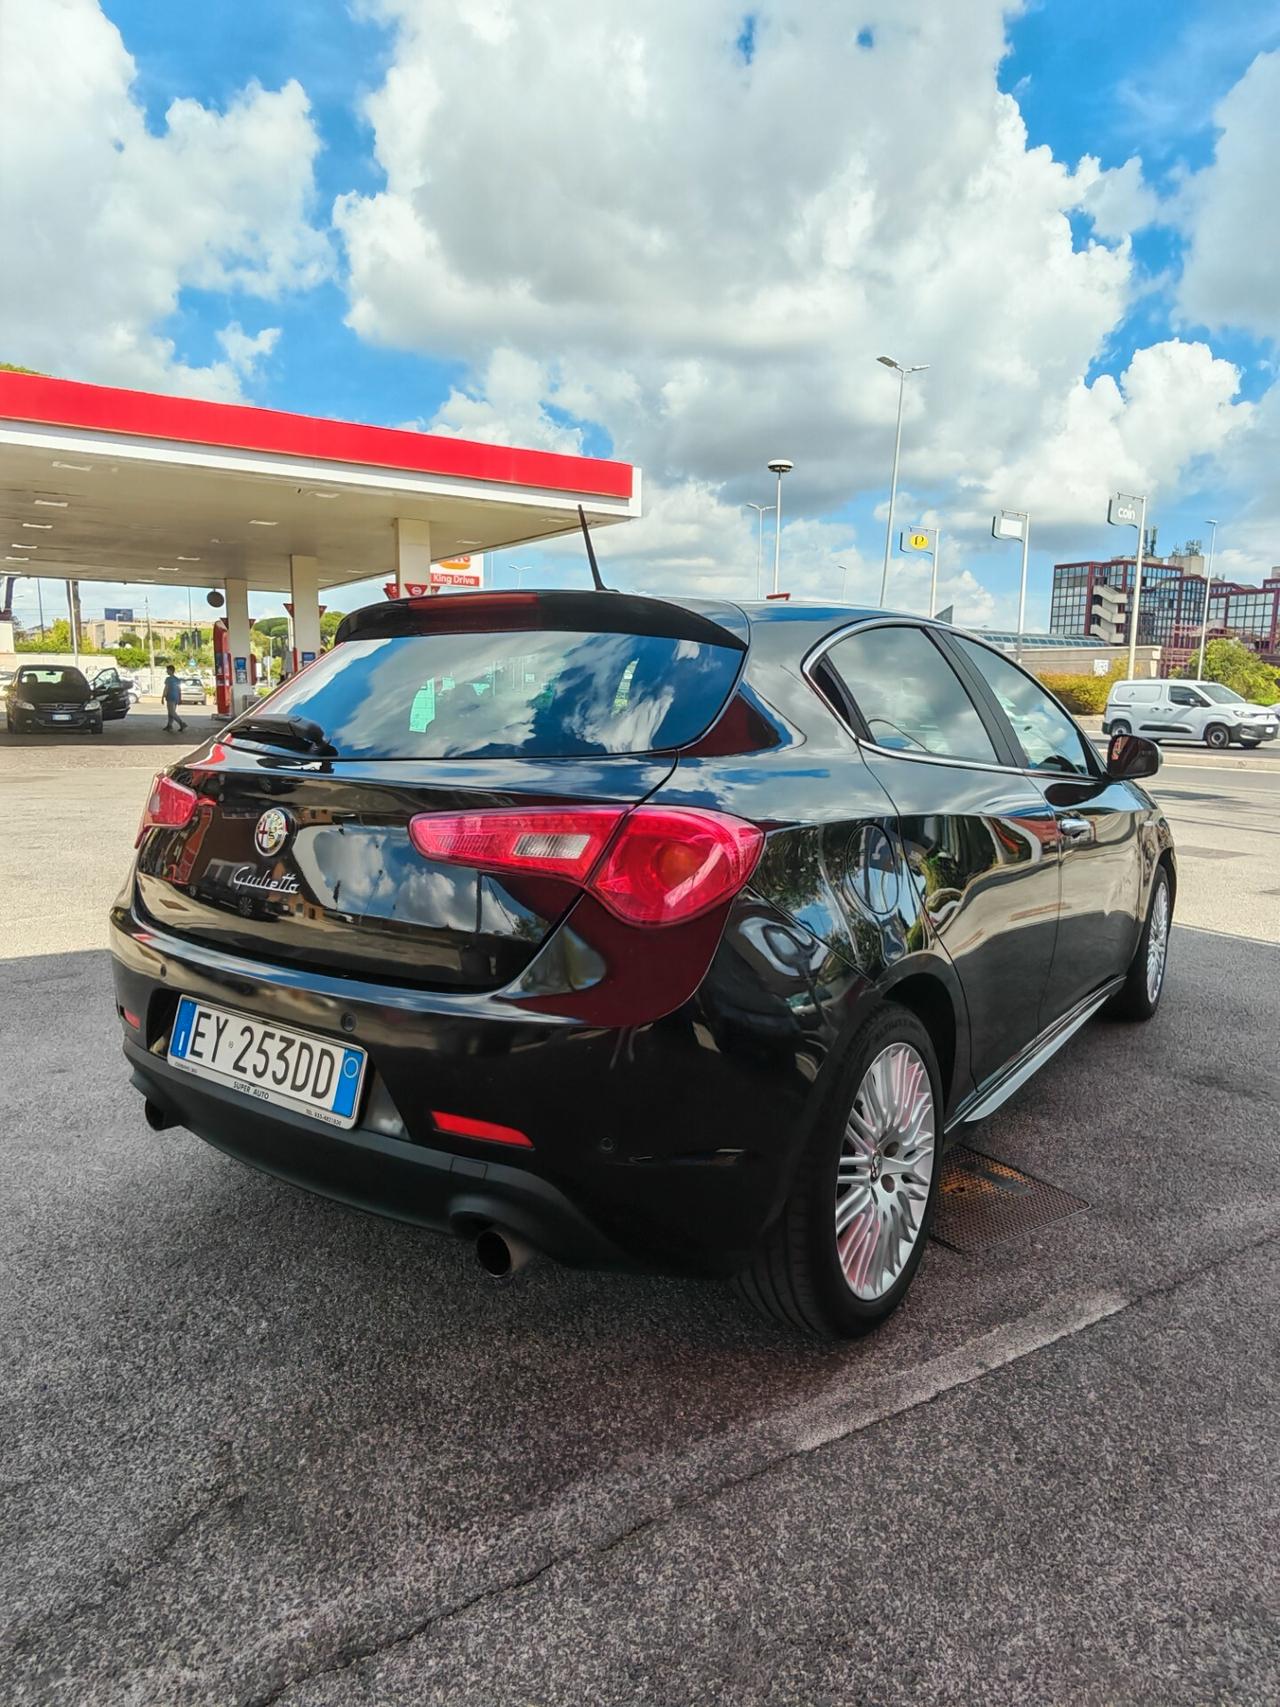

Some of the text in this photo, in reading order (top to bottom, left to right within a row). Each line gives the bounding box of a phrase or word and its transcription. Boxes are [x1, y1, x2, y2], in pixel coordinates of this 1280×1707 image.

[1118, 503, 1136, 521] coin
[433, 574, 475, 585] King Drive
[233, 866, 299, 894] Giulietta
[232, 1025, 335, 1099] 253DD
[233, 1080, 270, 1100] SUPER AUTO
